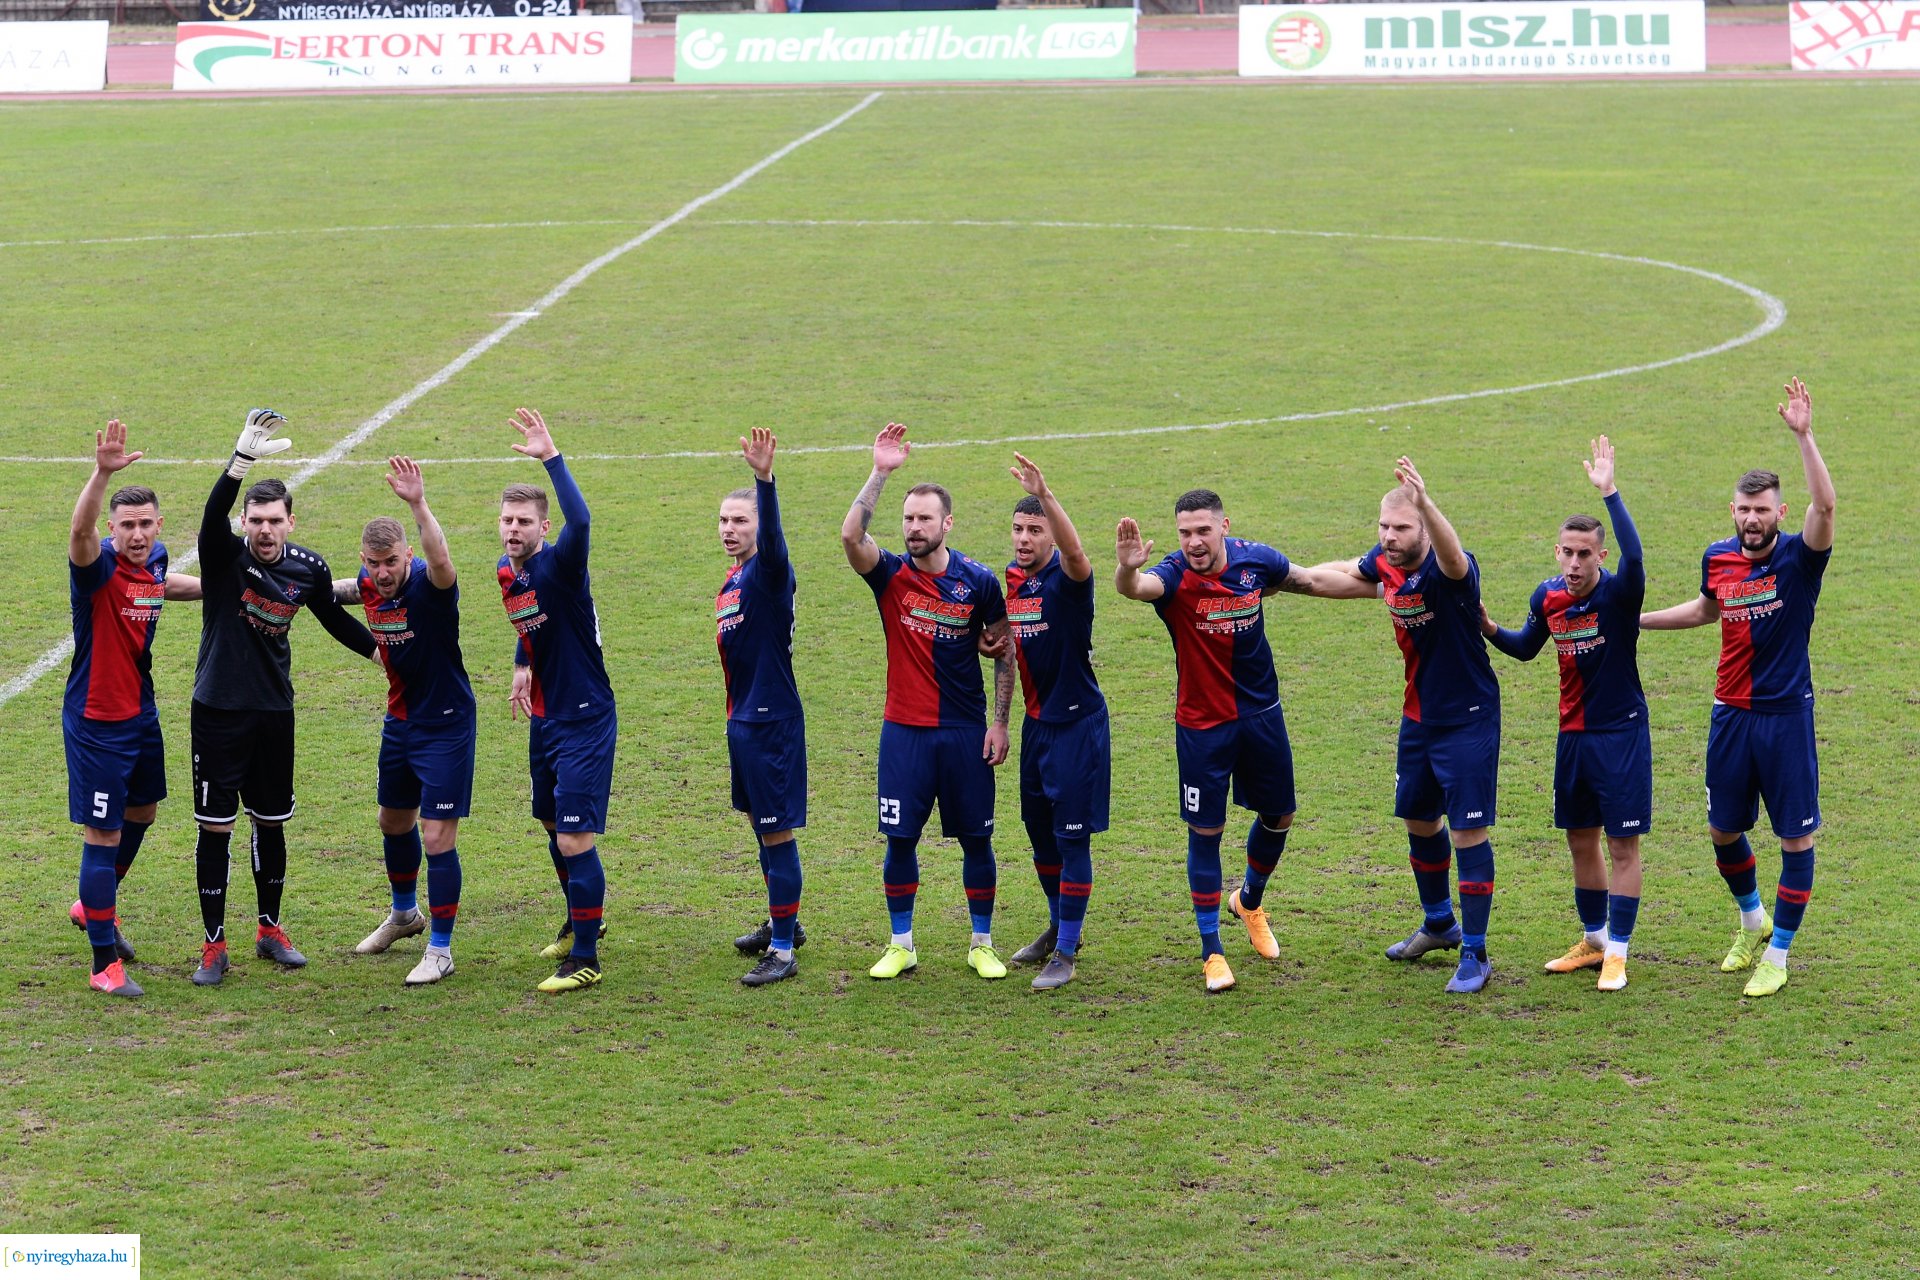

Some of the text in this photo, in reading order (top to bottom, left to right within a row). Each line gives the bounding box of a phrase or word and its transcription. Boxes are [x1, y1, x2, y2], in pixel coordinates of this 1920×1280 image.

[279, 0, 572, 20] NYÍREGYHÁZA-NYÍRPLÁZA 0-24
[1364, 9, 1670, 49] mlsz.hu
[271, 31, 605, 60] LERTON TRANS
[736, 25, 1118, 62] merkantilbank LIGA
[328, 64, 542, 77] HUNGARY
[1364, 51, 1671, 69] Magyar Labdarúgó Szövetség
[126, 582, 165, 599] REVE
[1716, 575, 1777, 600] REVESZ
[902, 591, 975, 619] REVESZ
[1005, 597, 1043, 614] EVESZ
[1196, 588, 1262, 614] REVESZ
[92, 791, 109, 819] 5
[202, 781, 209, 807] 1
[1183, 783, 1200, 813] 19
[563, 815, 580, 823] JAKO
[760, 816, 777, 824] JAKO
[880, 797, 901, 825] 23
[1466, 811, 1483, 819] JAKO
[1065, 823, 1083, 831] JAKO
[1622, 819, 1640, 828] JAKO
